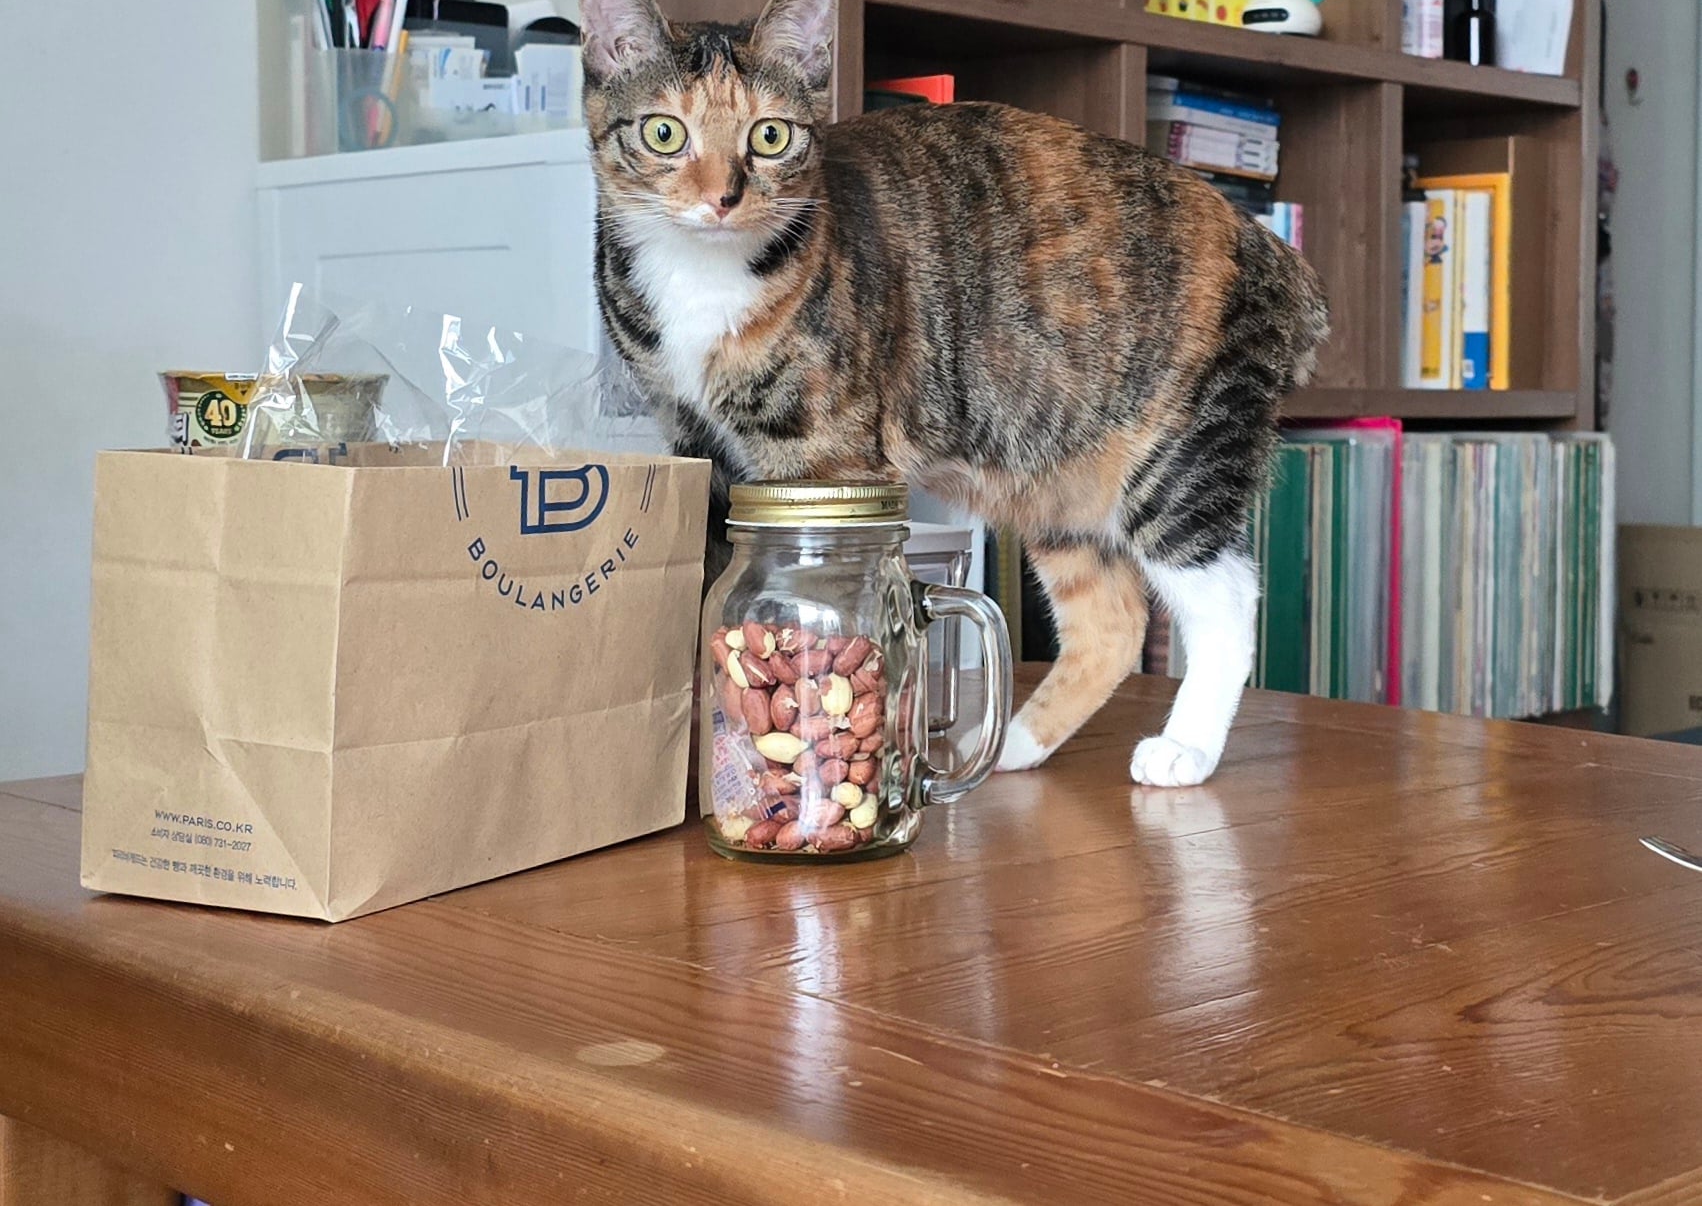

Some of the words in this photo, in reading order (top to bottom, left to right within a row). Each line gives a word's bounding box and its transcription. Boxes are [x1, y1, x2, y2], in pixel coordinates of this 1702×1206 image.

[204, 399, 236, 427] 40
[467, 528, 639, 611] BOULANGERIE
[154, 809, 253, 834] WWW.PARIS.CO.KR
[171, 830, 192, 844] 상담실
[214, 838, 251, 852] 731-2027
[255, 874, 297, 891] 노력합니다.
